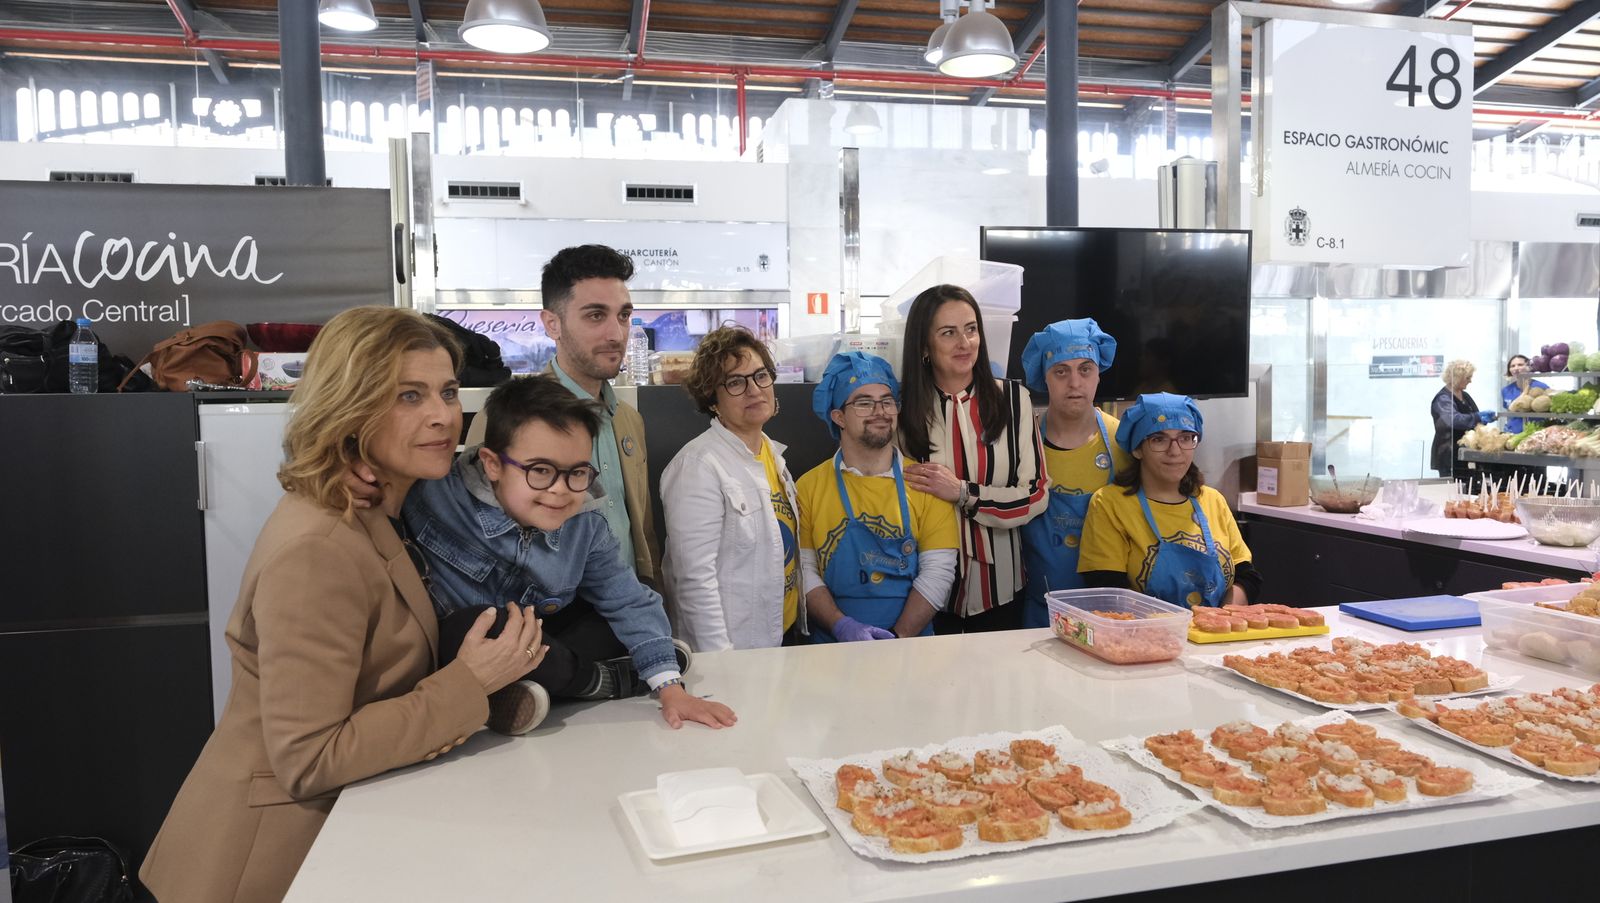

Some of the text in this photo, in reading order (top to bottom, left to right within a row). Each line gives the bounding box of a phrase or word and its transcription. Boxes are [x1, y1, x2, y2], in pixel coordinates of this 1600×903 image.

[1385, 45, 1462, 110] 48
[1283, 130, 1449, 155] ESPACIO GASTRONÓMIC
[1345, 160, 1451, 180] ALMERÍA COCIN
[1316, 236, 1345, 249] C-8.1
[643, 257, 679, 266] CANTÓN
[0, 299, 72, 322] cado
